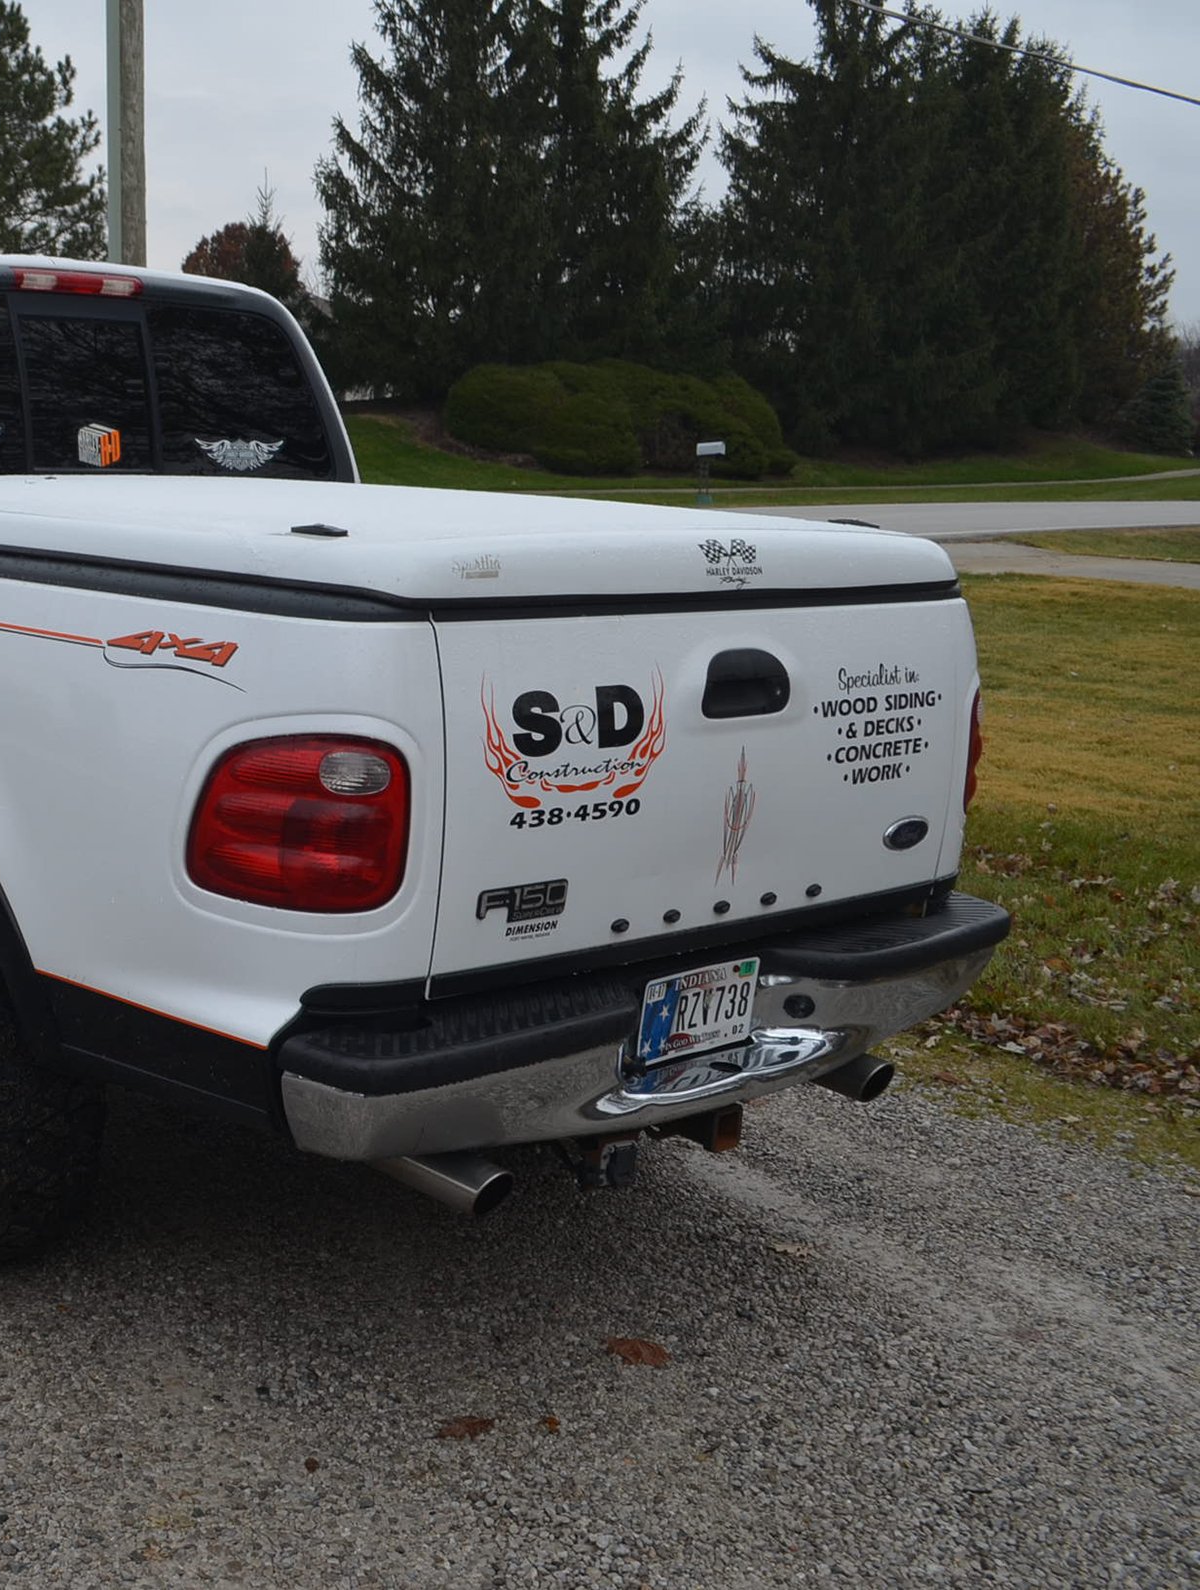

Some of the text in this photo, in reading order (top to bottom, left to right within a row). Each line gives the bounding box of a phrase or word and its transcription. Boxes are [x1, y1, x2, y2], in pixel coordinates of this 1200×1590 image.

[706, 566, 763, 576] HARLEY DAVIDSON
[838, 663, 901, 695] Specialist
[821, 690, 936, 718] WOOD SIDING
[512, 685, 644, 757] S&D
[846, 716, 915, 739] & DECKS
[834, 737, 922, 764] CONCRETE
[506, 757, 644, 783] Construction
[851, 762, 903, 785] WORK
[505, 920, 559, 937] DIMENSION
[675, 967, 728, 991] INDIANA
[731, 1024, 744, 1035] 02
